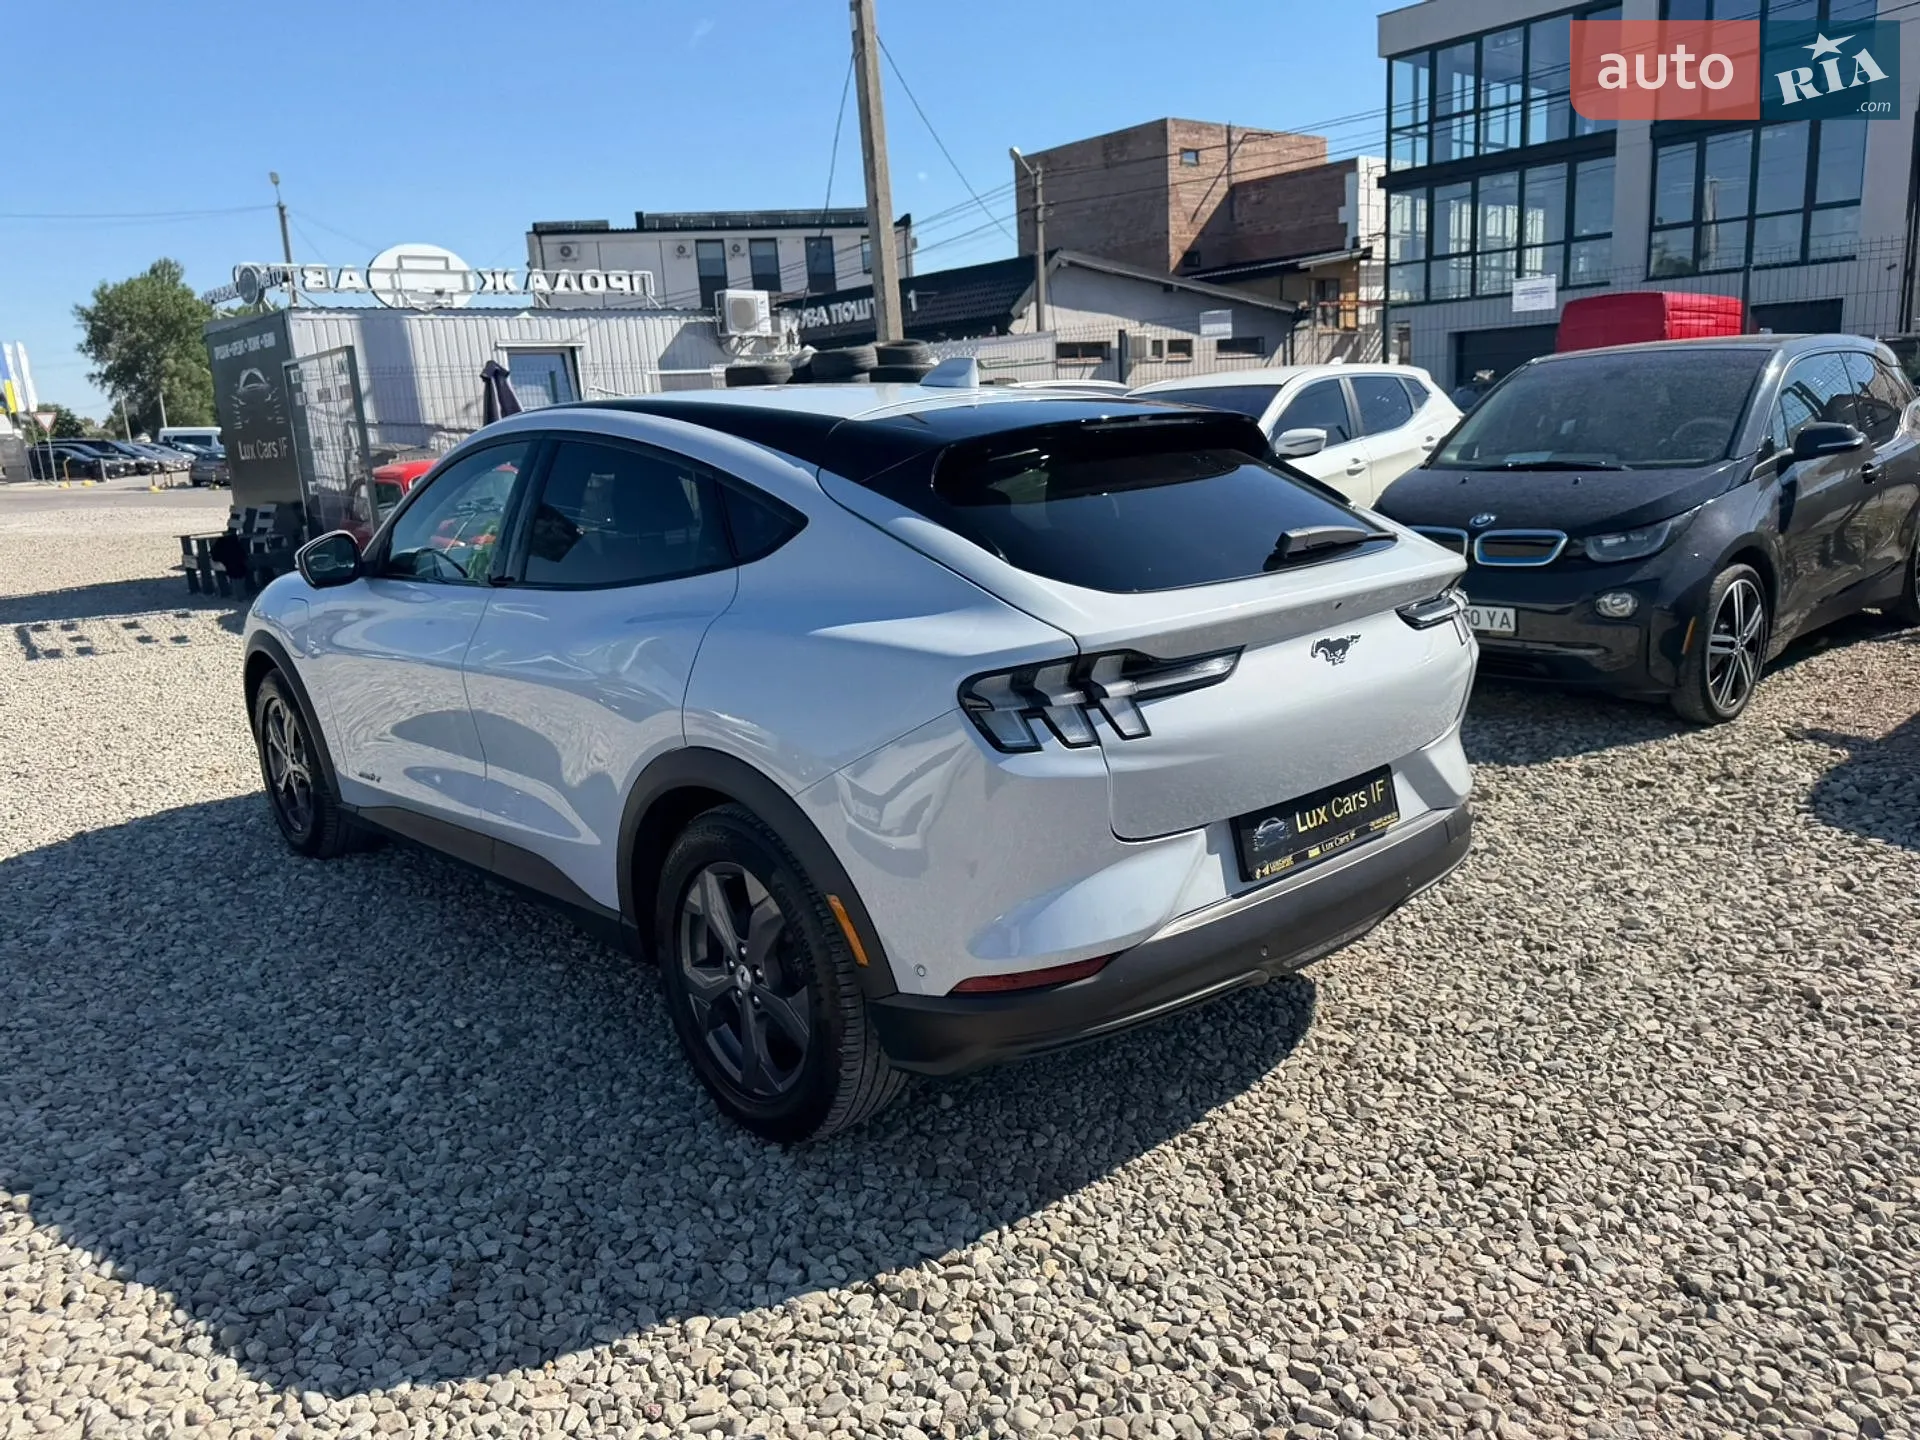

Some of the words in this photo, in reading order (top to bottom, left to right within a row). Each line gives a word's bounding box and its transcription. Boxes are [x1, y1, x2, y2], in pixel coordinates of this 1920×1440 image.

[237, 440, 256, 460] Lux
[255, 439, 279, 460] Cars
[1486, 610, 1512, 629] YA
[1295, 804, 1329, 832] Lux
[1331, 790, 1368, 819] Cars
[1370, 779, 1385, 803] IF
[1334, 834, 1350, 847] Cars
